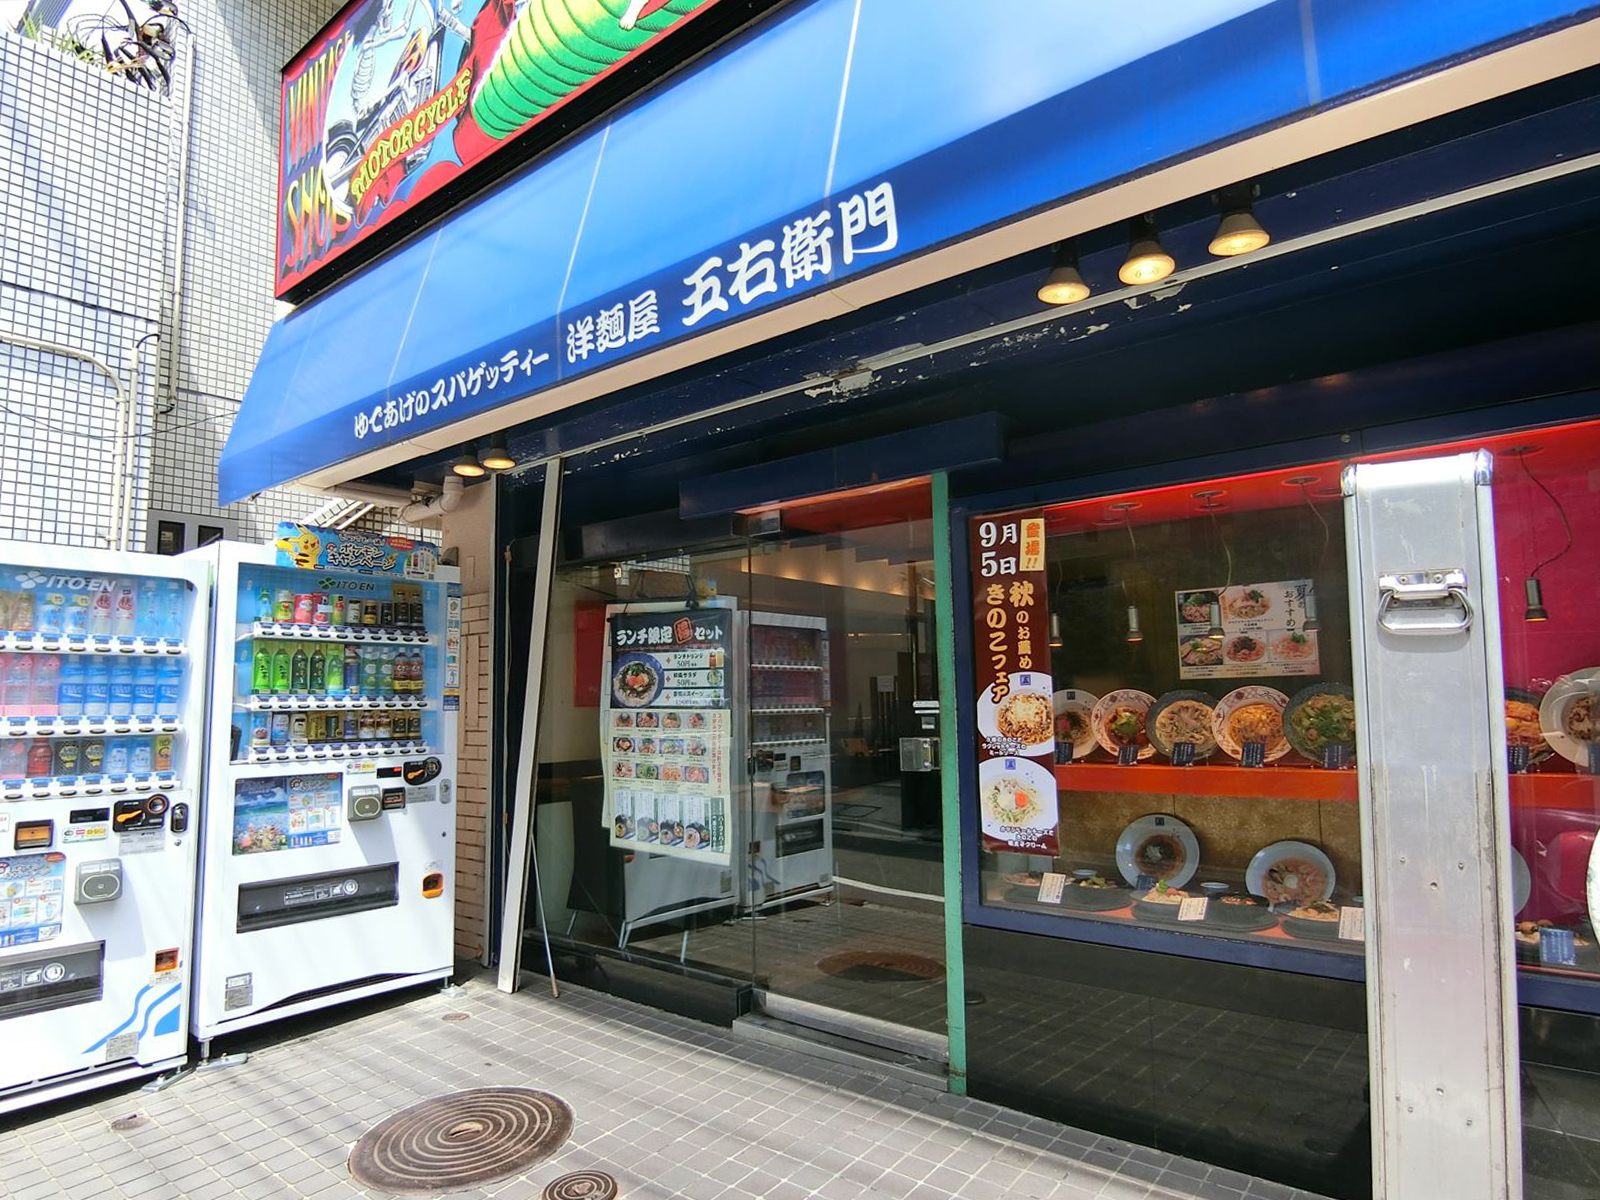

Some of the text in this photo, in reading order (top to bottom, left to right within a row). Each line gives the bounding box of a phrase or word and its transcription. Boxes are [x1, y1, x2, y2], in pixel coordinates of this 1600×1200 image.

[349, 67, 474, 205] MOTORCYCLE
[353, 348, 551, 439] ゆであげのスパゲッティー
[681, 181, 899, 328] 五右衛門
[979, 521, 1018, 548] 9月
[327, 552, 397, 571] キャンペーン
[340, 543, 386, 559] ポケモン
[980, 551, 1017, 578] 5日
[1283, 589, 1297, 628] おすすめ
[694, 625, 723, 640] セット
[986, 583, 1009, 702] きのこフェア
